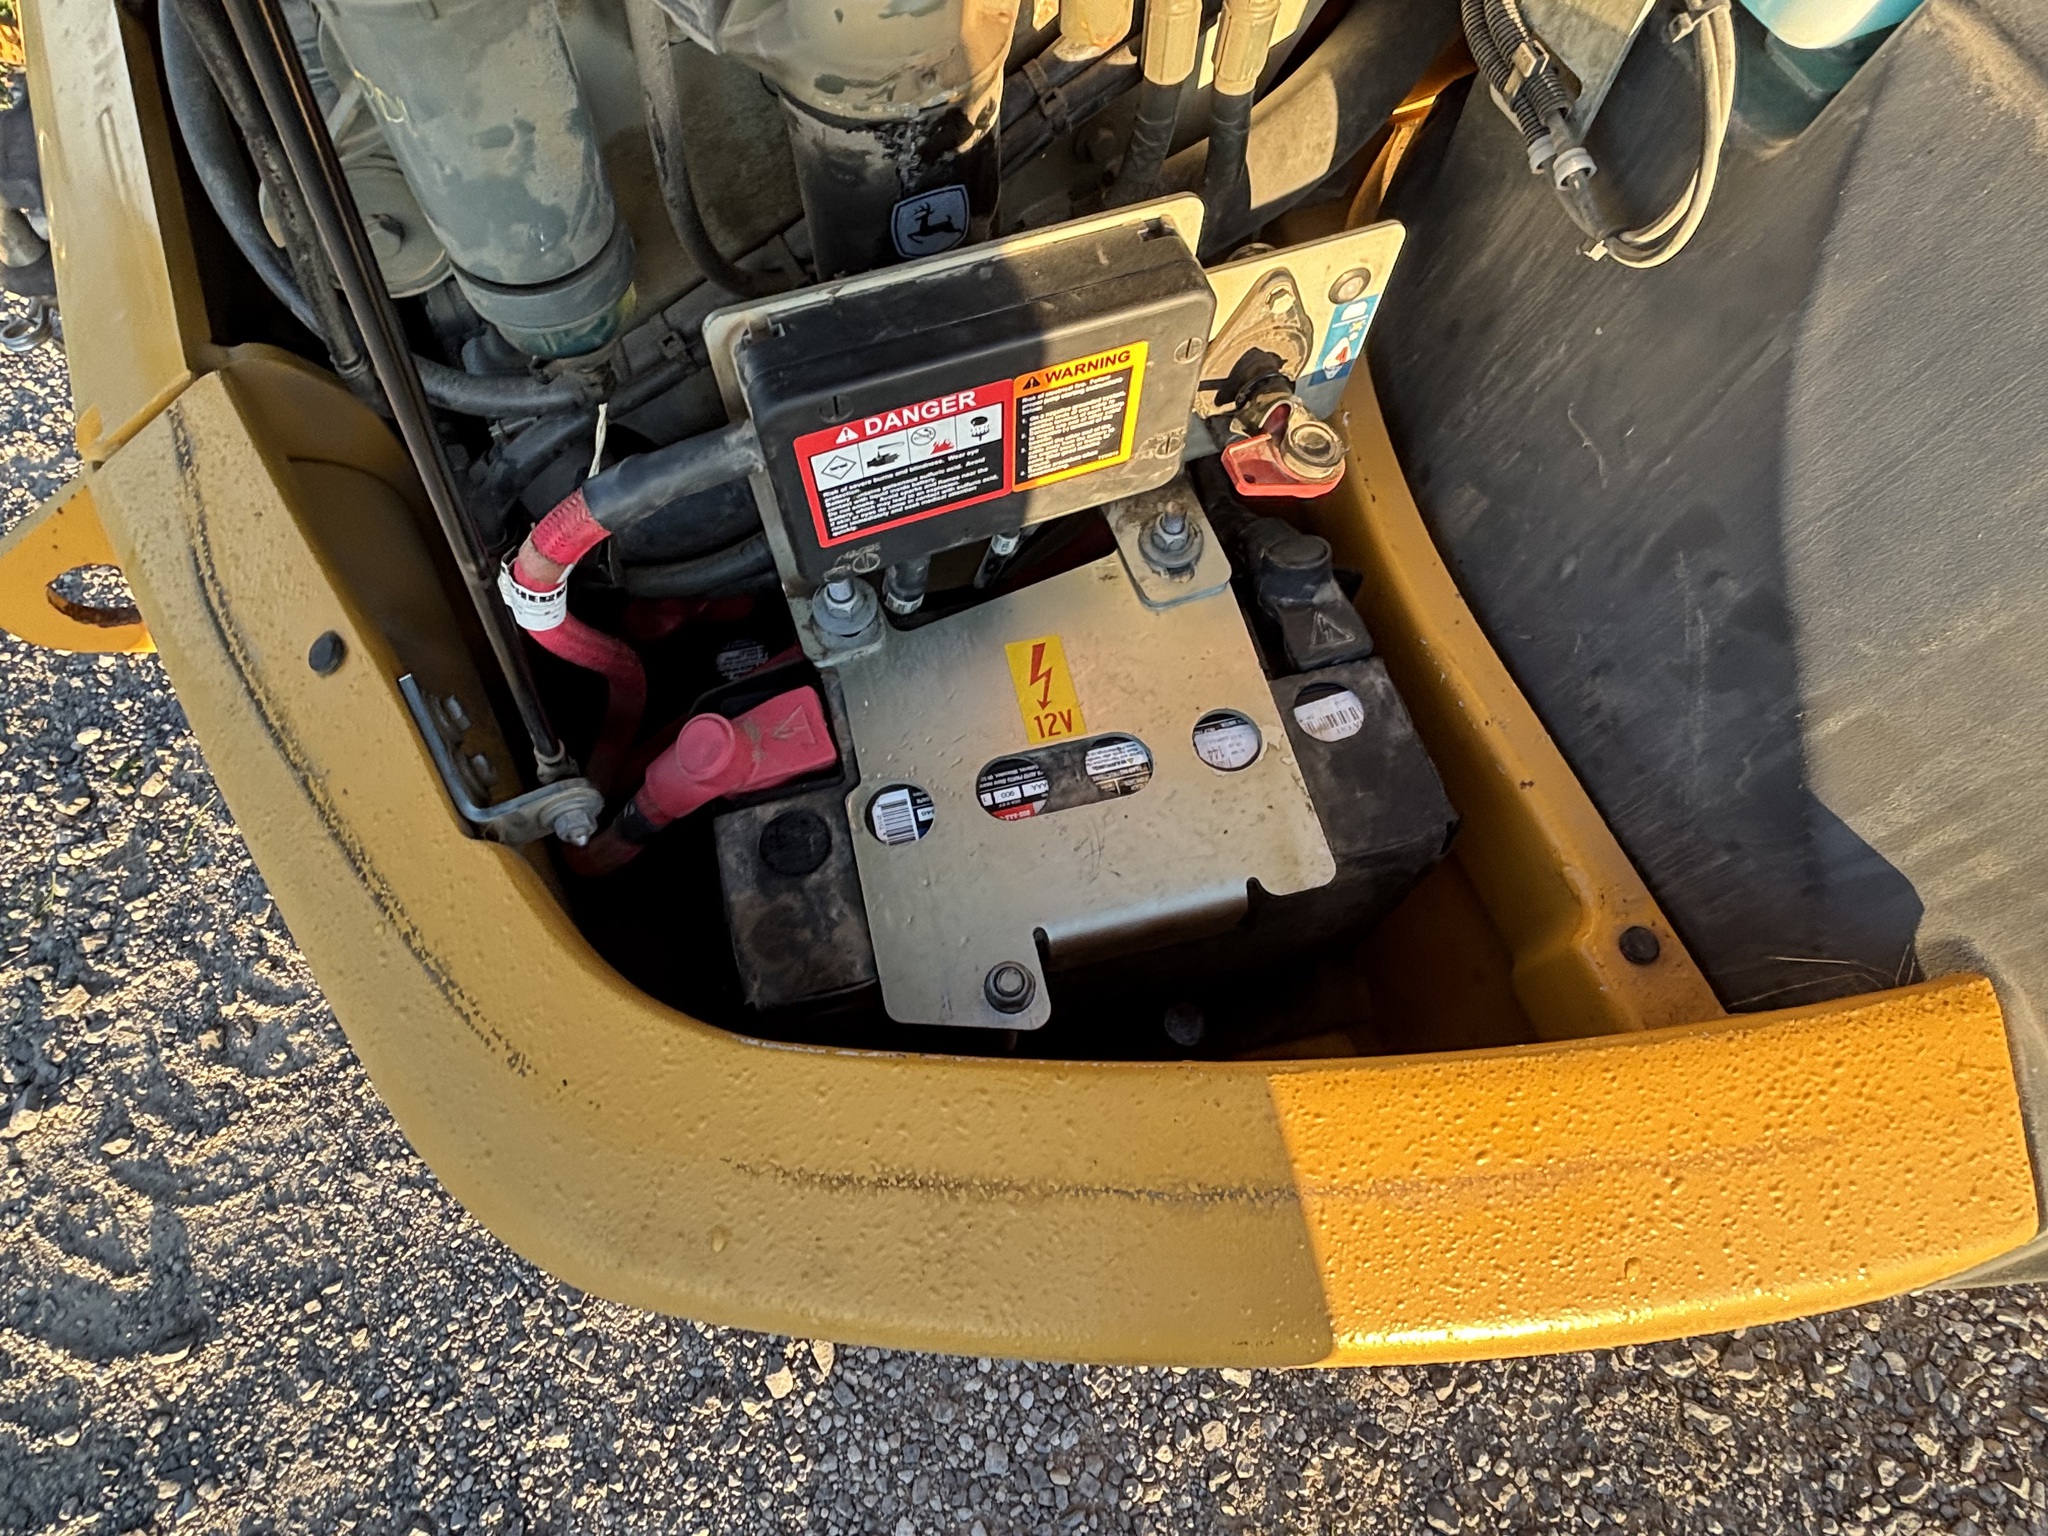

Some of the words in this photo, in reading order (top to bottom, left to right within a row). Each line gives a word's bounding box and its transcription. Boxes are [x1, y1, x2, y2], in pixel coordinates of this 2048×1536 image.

[1045, 350, 1131, 383] WARNING
[864, 390, 976, 436] DANGER
[822, 489, 838, 497] Risk
[848, 480, 872, 489] severe
[873, 473, 893, 482] burns
[909, 458, 944, 472] blindness.
[947, 452, 965, 461] Wear
[825, 497, 850, 507] Battery
[946, 464, 962, 472] acid.
[965, 457, 985, 466] Avoid
[879, 493, 898, 501] Avoid
[961, 470, 976, 478] near
[860, 510, 876, 518] eyes
[887, 501, 906, 509] come
[920, 494, 946, 505] medical
[1034, 709, 1072, 738] 12V
